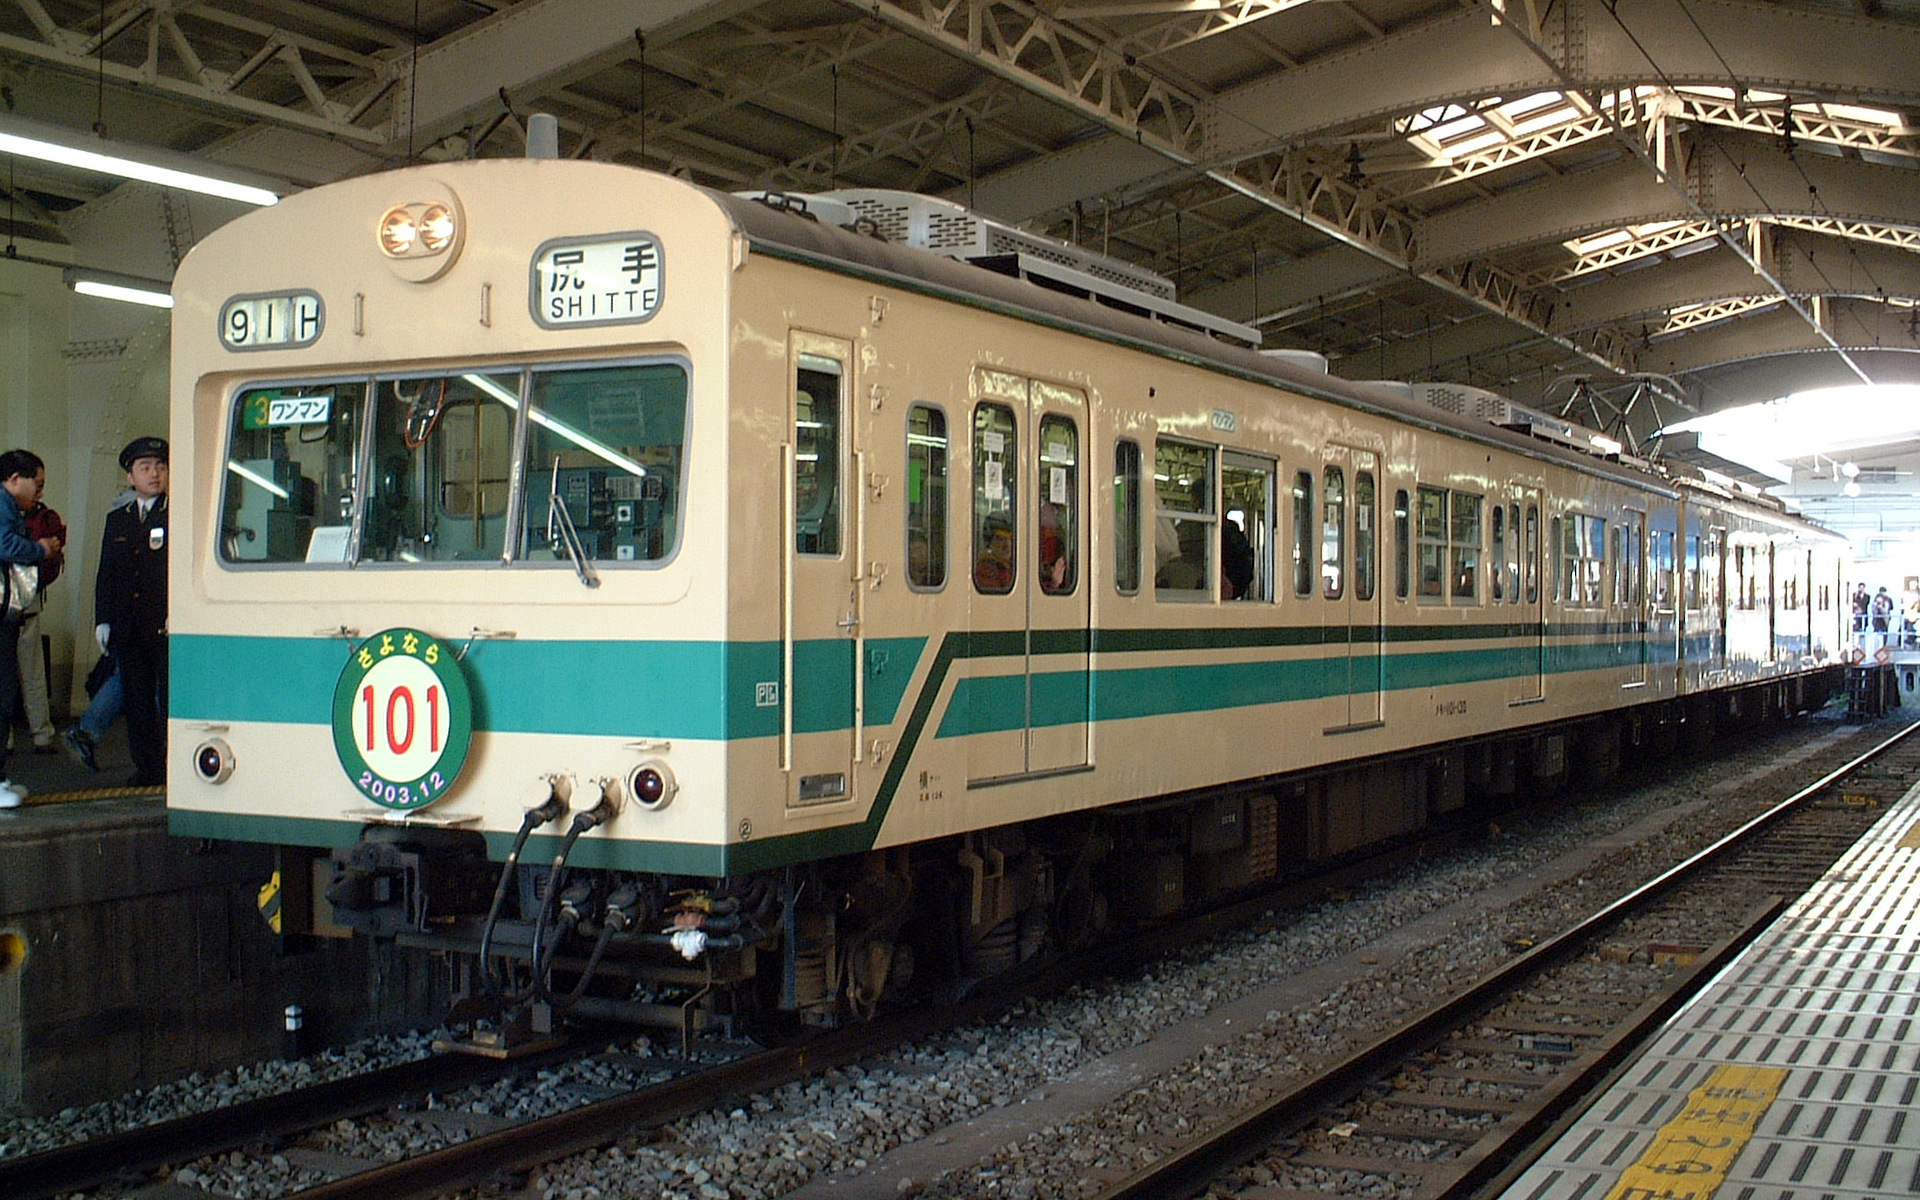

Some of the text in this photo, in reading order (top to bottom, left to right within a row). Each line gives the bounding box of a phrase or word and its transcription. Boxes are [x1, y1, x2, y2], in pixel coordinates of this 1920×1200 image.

[550, 242, 656, 292] 尻手
[551, 288, 656, 318] SHITTE
[272, 402, 327, 420] ワンマン
[358, 632, 439, 669] さよなら
[363, 684, 438, 755] 101
[359, 771, 445, 804] 2003.12
